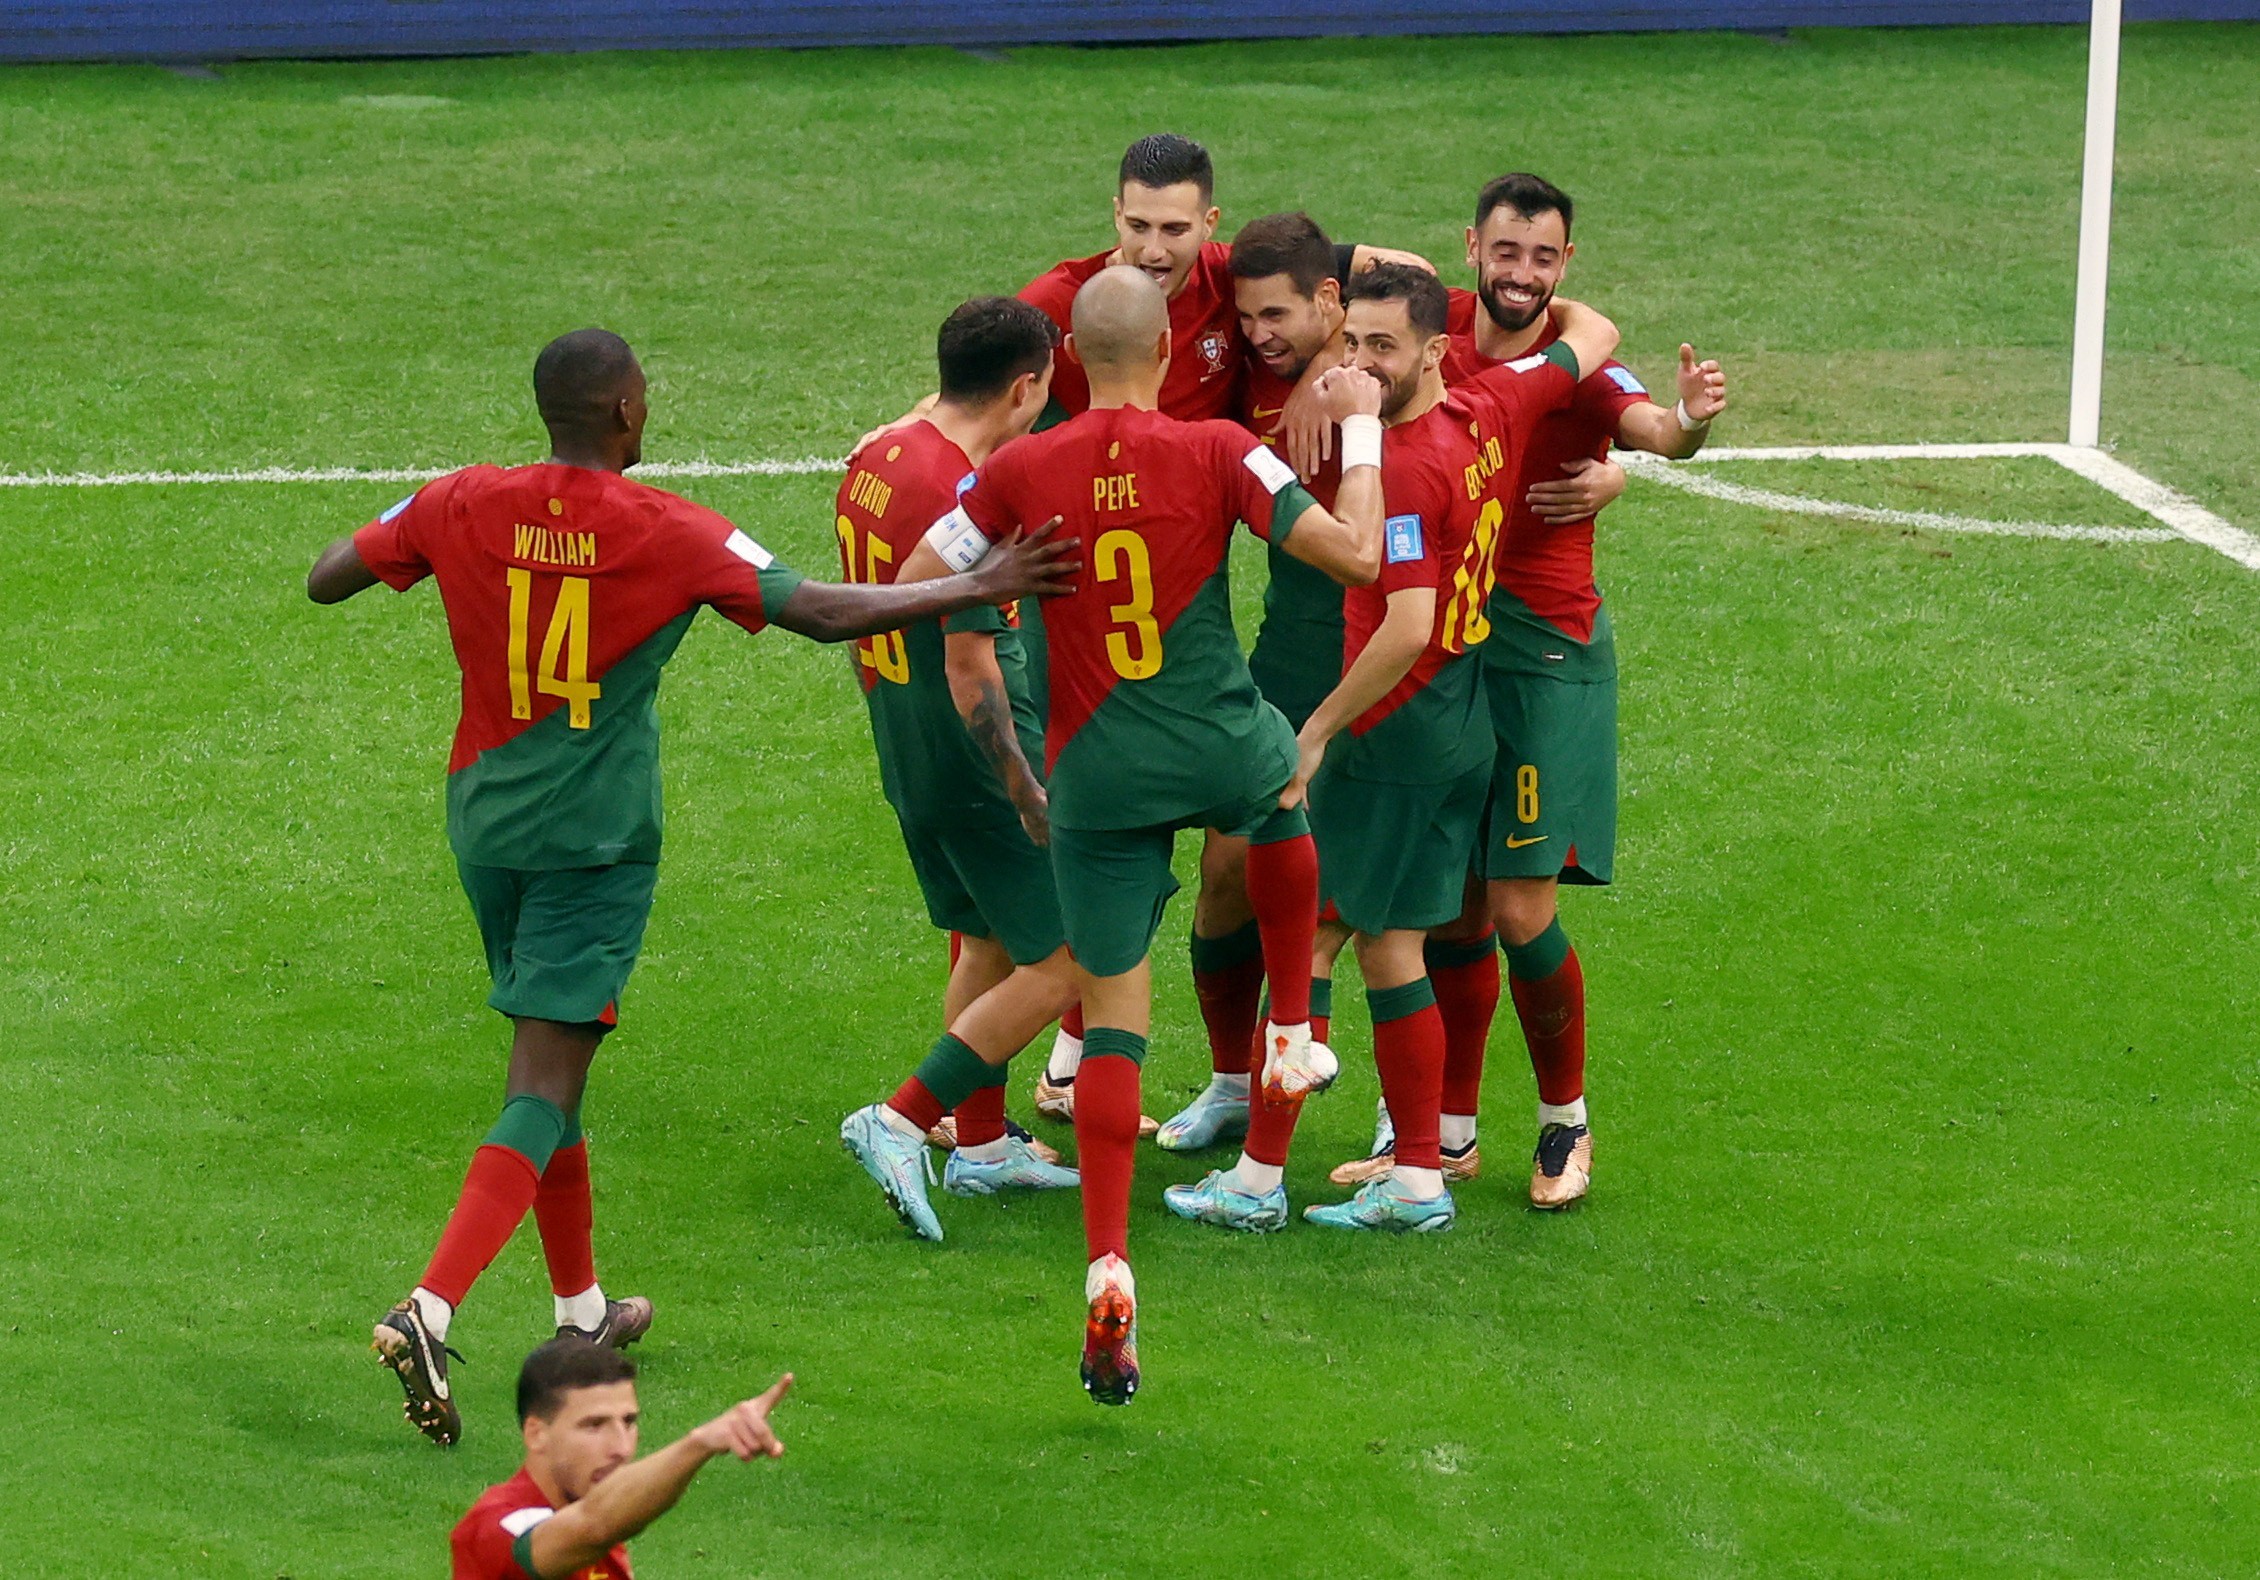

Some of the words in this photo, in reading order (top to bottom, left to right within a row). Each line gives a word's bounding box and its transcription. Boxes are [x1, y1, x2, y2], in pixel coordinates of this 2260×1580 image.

[1093, 473, 1140, 511] PEPE
[513, 522, 597, 567] WILLIAM
[1093, 529, 1163, 680] 3
[506, 566, 601, 730] 14
[1516, 764, 1538, 824] 8
